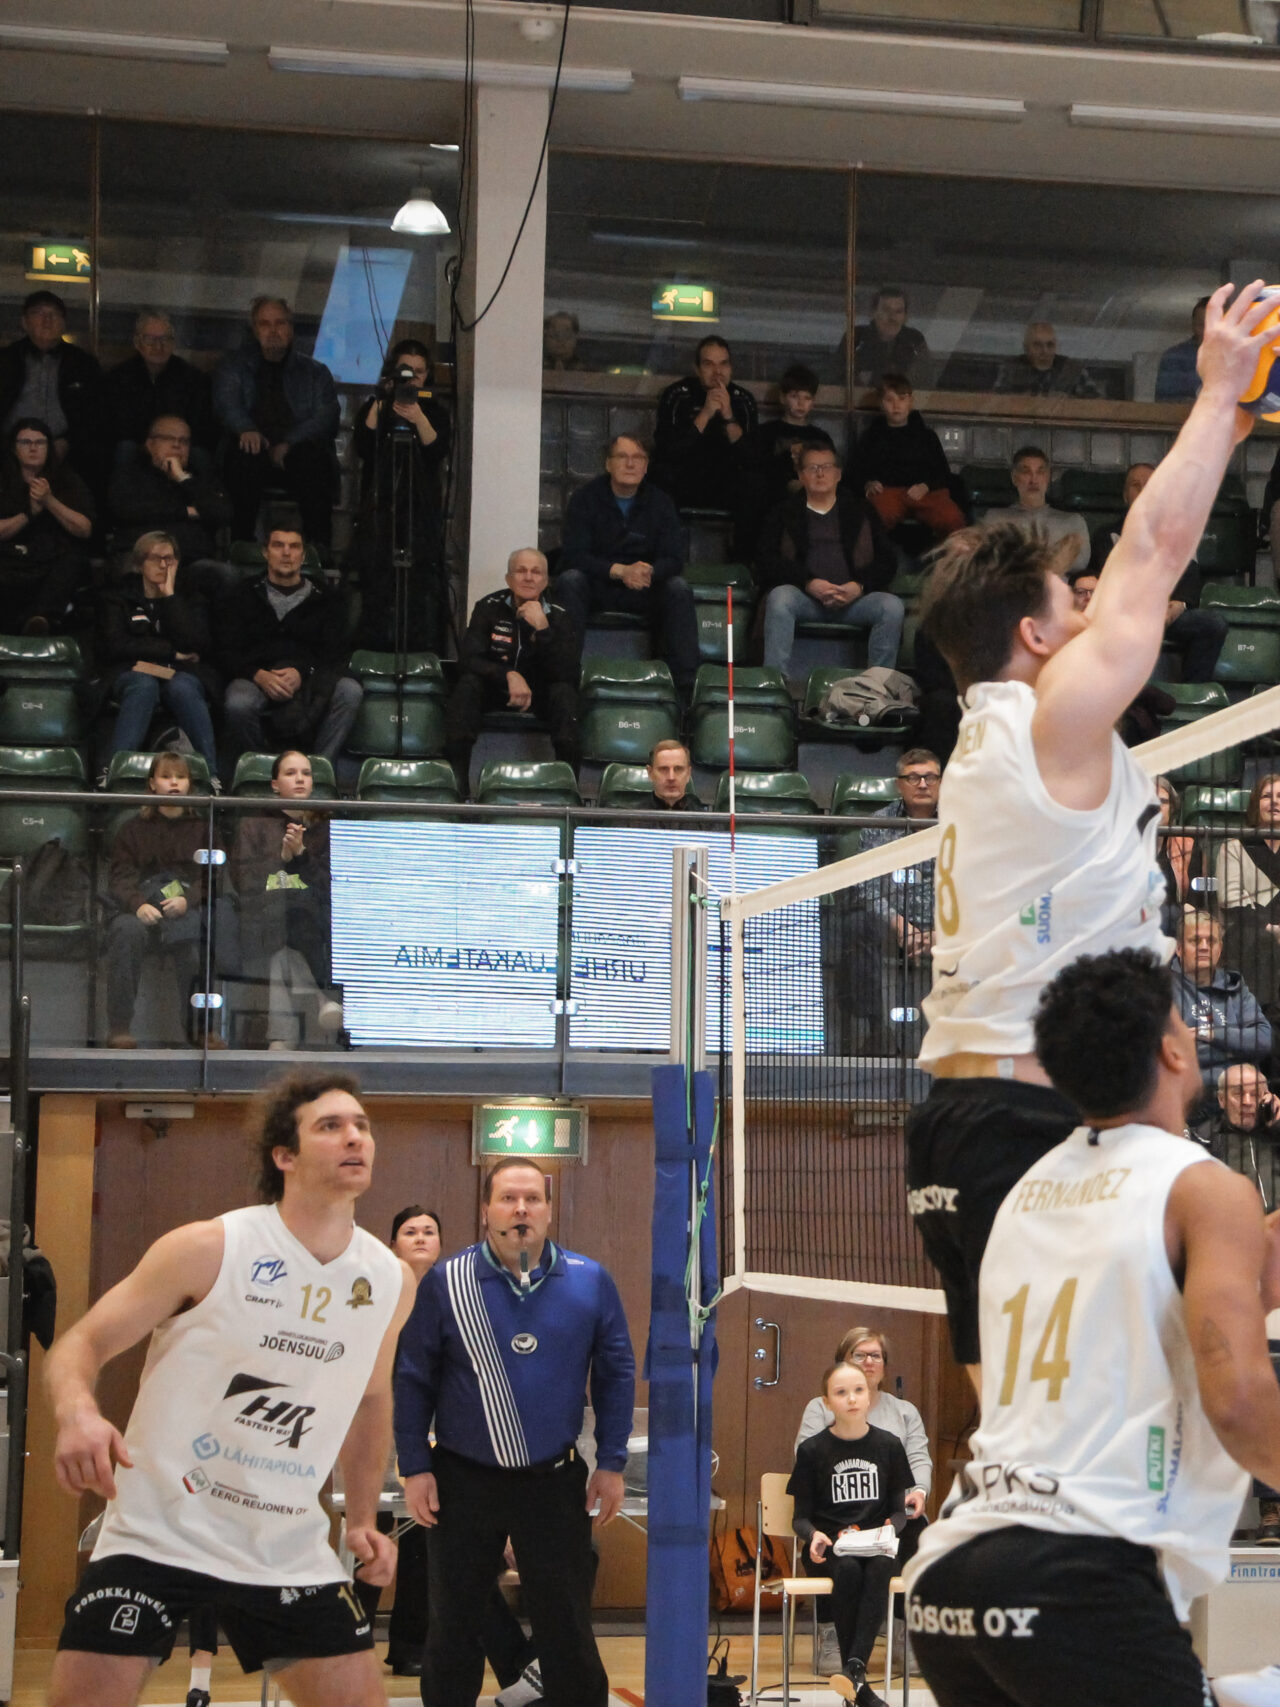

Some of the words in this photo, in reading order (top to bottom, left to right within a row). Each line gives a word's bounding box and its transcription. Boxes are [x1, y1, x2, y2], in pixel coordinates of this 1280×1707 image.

[938, 823, 960, 937] 8
[1012, 1168, 1132, 1214] FERNANDEZ
[245, 1294, 276, 1307] CRAFT
[300, 1283, 332, 1324] 12
[259, 1335, 326, 1360] JOENSUU
[998, 1277, 1078, 1406] 14
[234, 1416, 275, 1434] FASTEST
[223, 1446, 316, 1478] LÄHITAPIOLA
[1149, 1434, 1161, 1482] PUTKI
[211, 1488, 240, 1504] EERO
[242, 1499, 293, 1515] REIJONEN
[832, 1471, 879, 1503] KARI
[983, 1606, 1040, 1637] OY
